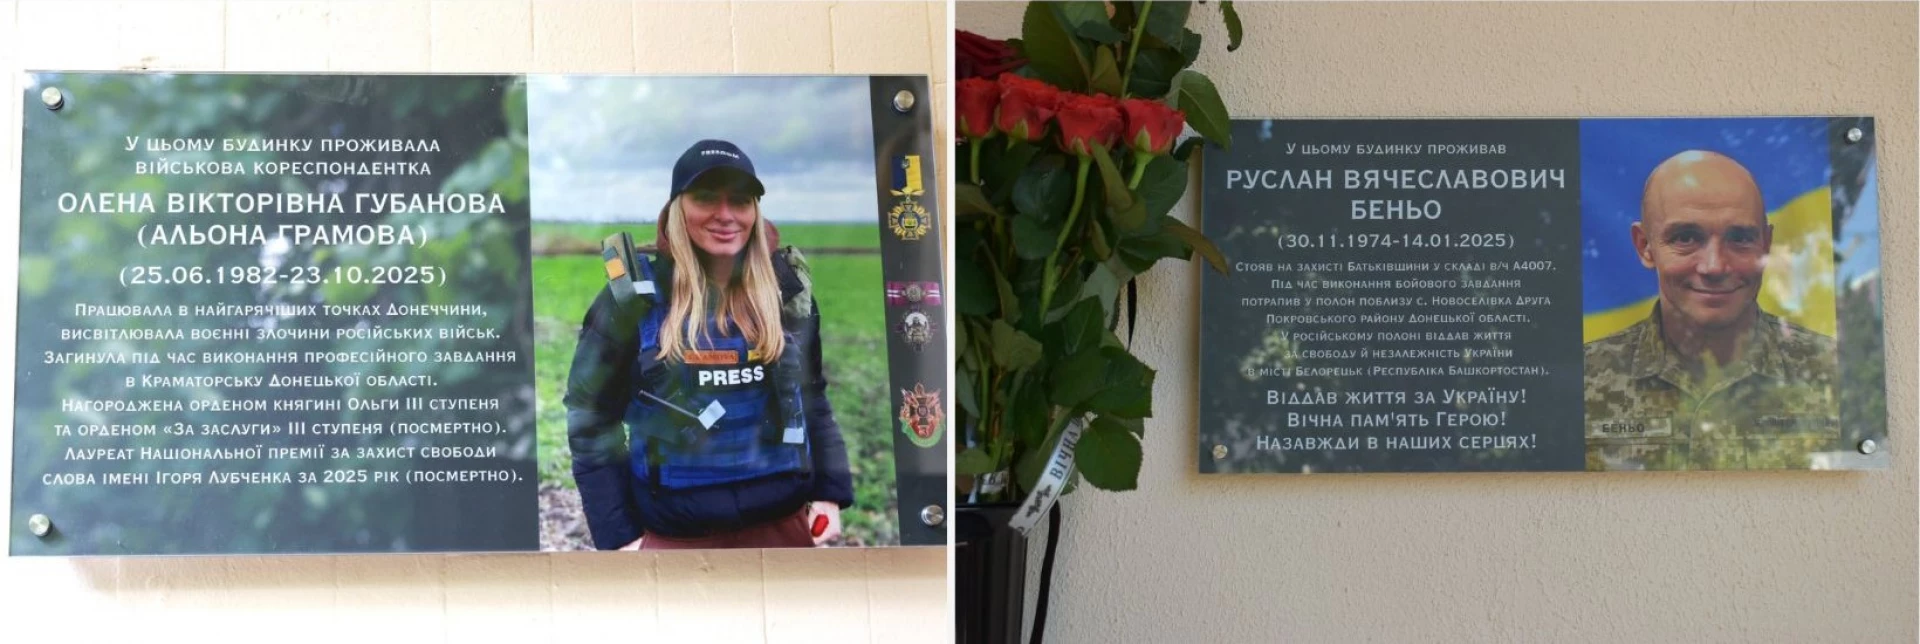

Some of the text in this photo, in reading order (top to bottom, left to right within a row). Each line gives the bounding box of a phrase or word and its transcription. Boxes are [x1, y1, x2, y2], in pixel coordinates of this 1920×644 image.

[125, 136, 441, 153] У ЦЬОМУ БУДИНКУ ПРОЖИВАЛА
[1286, 143, 1507, 155] У ЦЬОМУ БУДИНКУ ПРОЖИВАВ
[136, 158, 432, 176] ВІЙСЬКОВА КОРЕСПОНДЕНТКА
[1226, 169, 1565, 190] РУСЛАН ВЯЧЕСЛАВОВИЧ
[58, 192, 506, 214] ОЛЕНА ВІКТОРІВНА ГУБАНОВА
[1351, 200, 1442, 220] БЕНЬО
[137, 224, 427, 248] (АЛЬОНА ГРАМОВА)
[1278, 233, 1514, 250] (30.11.1974-14.01.2025)
[1235, 262, 1273, 272] СТОЯВ
[1297, 263, 1343, 272] ЗАХИСТІ
[1348, 262, 1429, 272] БАТЬКІВЩИНИ
[1434, 263, 1440, 271] У
[1444, 263, 1485, 271] СКЛАДІ
[1490, 262, 1508, 271] В/Ч
[1513, 261, 1556, 271] А4007.
[119, 265, 447, 287] (25.06.1982-23.10.2025)
[1271, 280, 1292, 289] ПІД
[1297, 281, 1318, 289] ЧАС
[1396, 278, 1457, 288] БОЙОВОГО
[1461, 280, 1521, 288] ЗАВДАННЯ
[1241, 298, 1300, 306] ПОТРАПИВ
[1305, 298, 1311, 306] У
[1433, 296, 1512, 305] НОВОСЕЛІВКА
[1516, 296, 1550, 305] ДРУГА
[75, 302, 487, 317] ПРАЦЮВАЛА В НАЙГАРЯЧІШИХ ТОЧКАХ ДОНЕЧЧИНИ,
[1266, 312, 1530, 323] ПОКРОВСЬКОГО РАЙОНУ ДОНЕЦЬКОЇ ОБЛАСТІ.
[61, 326, 500, 340] ВИСВІТЛЮВАЛА ВОЄННІ ЗЛОЧИНИ РОСІЙСЬКИХ ВІЙСЬК.
[1281, 332, 1289, 341] У
[1293, 331, 1373, 341] РОСІЙСЬКОМУ
[1426, 332, 1469, 340] ВІДДАВ
[1473, 332, 1511, 340] ЖИТТЯ
[44, 349, 516, 364] ЗАГИНУЛА ПІД ЧАС ВИКОНАННЯ ПРОФЕСІЙНОГО ЗАВДАННЯ
[1302, 350, 1356, 358] СВОБОДУ
[1361, 348, 1368, 358] Й
[1373, 350, 1460, 358] НЕЗАЛЕЖНІСТЬ
[1464, 347, 1513, 358] УКРАЇНИ
[699, 365, 764, 386] PRESS
[1260, 368, 1291, 376] МІСТІ
[1296, 367, 1363, 376] БЕЛОРЕЦЬК
[1367, 367, 1444, 376] (РЕСПУБЛІКА
[1449, 366, 1549, 376] БАШКОРТОСТАН).
[125, 372, 437, 387] В КРАМАТОРСЬКУ ДОНЕЦЬКОЇ ОБЛАСТІ.
[1267, 387, 1526, 404] ВІДДАВ ЖИТТЯ ЗА УКРАЇНУ!
[62, 399, 182, 412] НАГОРОДЖЕНА
[189, 400, 267, 412] ОРДЕНОМ
[274, 399, 341, 411] КНЯГИНІ
[348, 398, 399, 411] ОЛЬГИ
[429, 398, 499, 410] СТУПЕНЯ
[1288, 412, 1506, 427] ВІЧНА ПАМ'ЯТЬ ГЕРОЮ!
[54, 425, 71, 436] ТА
[78, 424, 156, 436] ОРДЕНОМ
[163, 423, 194, 436] «ЗА
[201, 423, 281, 436] ЗАСЛУГИ»
[312, 423, 382, 434] СТУПЕНЯ
[390, 422, 506, 435] (ПОСМЕРТНО).
[1256, 434, 1536, 450] НАЗАВЖДИ В НАШИХ СЕРЦЯХ!
[65, 444, 496, 460] ЛАУРЕАТ НАЦІОНАЛЬНОЇ ПРЕМІЇ ЗА ЗАХИСТ СВОБОДИ
[1050, 431, 1078, 480] ВІЧНА
[42, 469, 523, 485] СЛОВА ІМЕНІ ІГОРЯ ЛУБЧЕНКА ЗА 2025 РІК (ПОСМЕРТНО).
